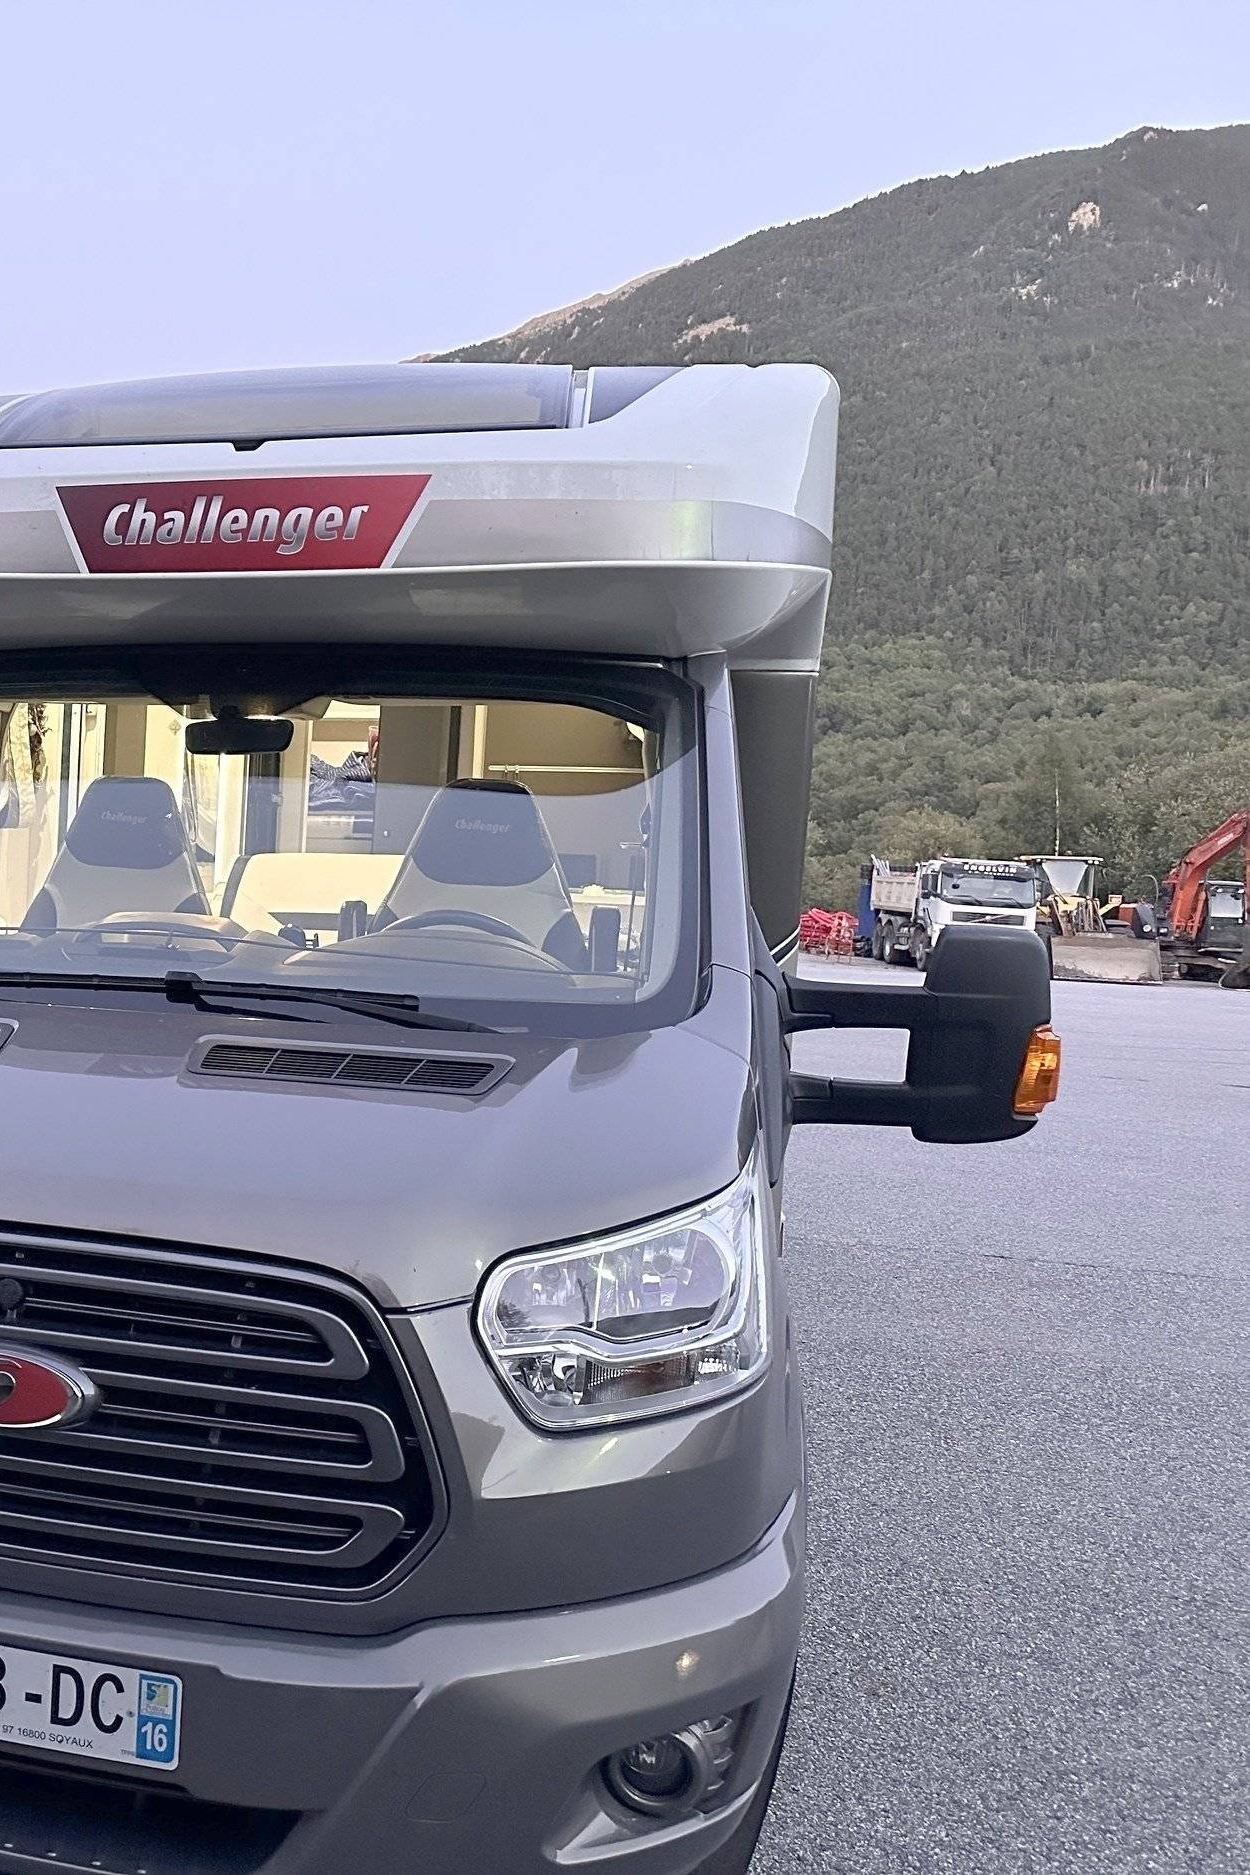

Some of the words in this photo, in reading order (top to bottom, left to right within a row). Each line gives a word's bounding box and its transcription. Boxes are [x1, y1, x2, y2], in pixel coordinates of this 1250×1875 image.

[102, 495, 370, 555] Challenger
[454, 818, 511, 834] Challenger
[2, 1724, 14, 1734] 97
[17, 1727, 47, 1741] 16800
[48, 1733, 94, 1749] SOYAUX
[141, 1721, 168, 1752] 16
